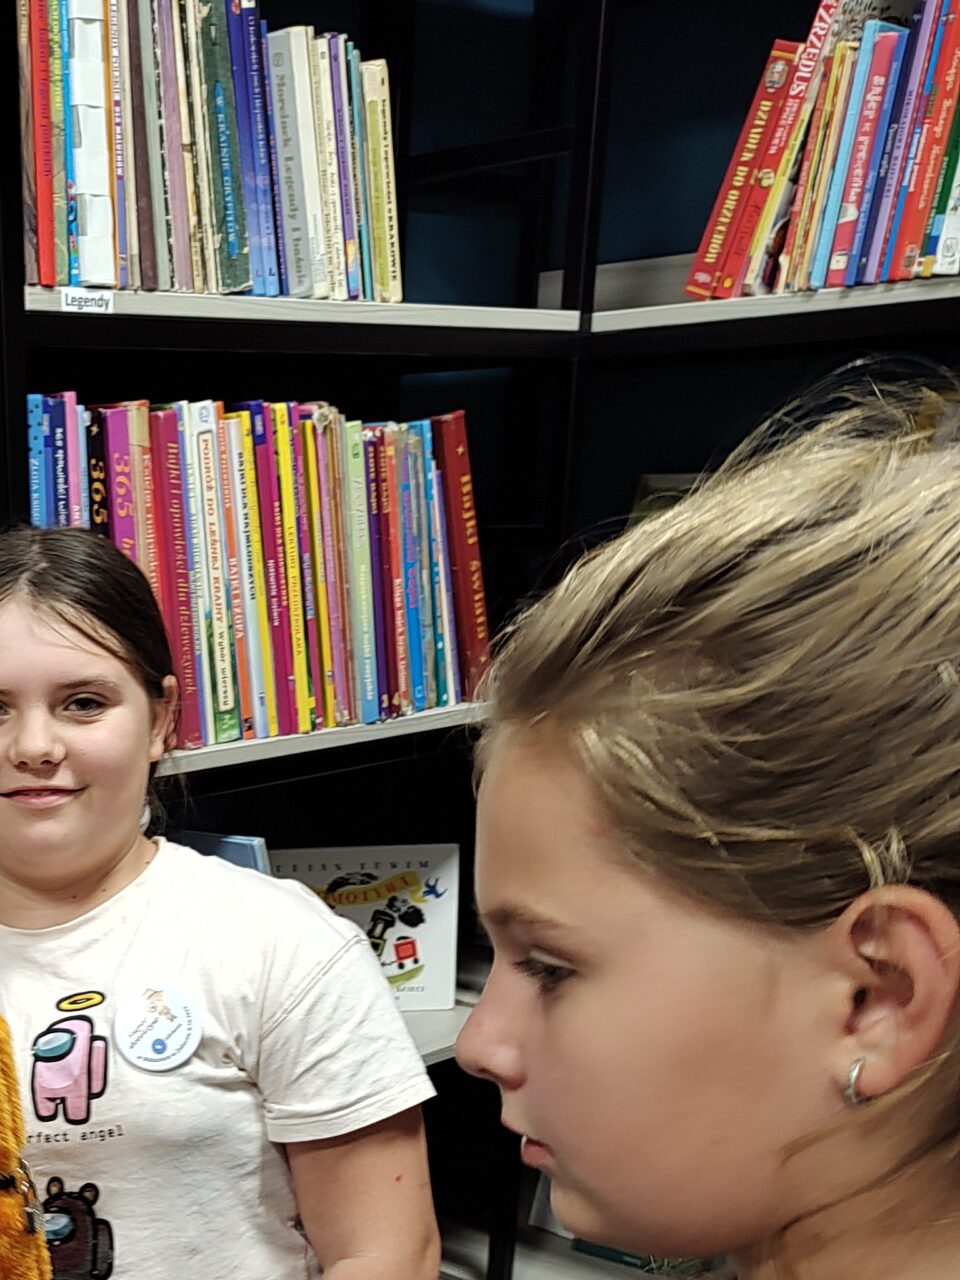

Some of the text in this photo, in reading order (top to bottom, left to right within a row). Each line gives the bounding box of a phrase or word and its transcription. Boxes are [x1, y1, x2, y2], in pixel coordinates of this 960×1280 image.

[739, 100, 774, 162] DZIADEK
[279, 155, 301, 221] Legendy
[65, 293, 110, 310] Legendy
[112, 452, 134, 518] 365
[166, 442, 180, 486] Bajki
[201, 438, 213, 493] PODRÓŻ
[30, 493, 42, 527] KSIĘG
[89, 458, 108, 524] 365
[241, 487, 251, 508] DLA
[168, 499, 186, 574] opowieści
[207, 522, 220, 571] LEŚNEJ
[459, 474, 486, 640] Bajki świata
[176, 579, 190, 603] dla
[211, 576, 223, 624] KRAINY
[228, 557, 244, 639] BAJKI EZOPA
[178, 606, 197, 695] dziewczynek
[220, 666, 230, 707] wierszy
[27, 1124, 126, 1144] rfect angel
